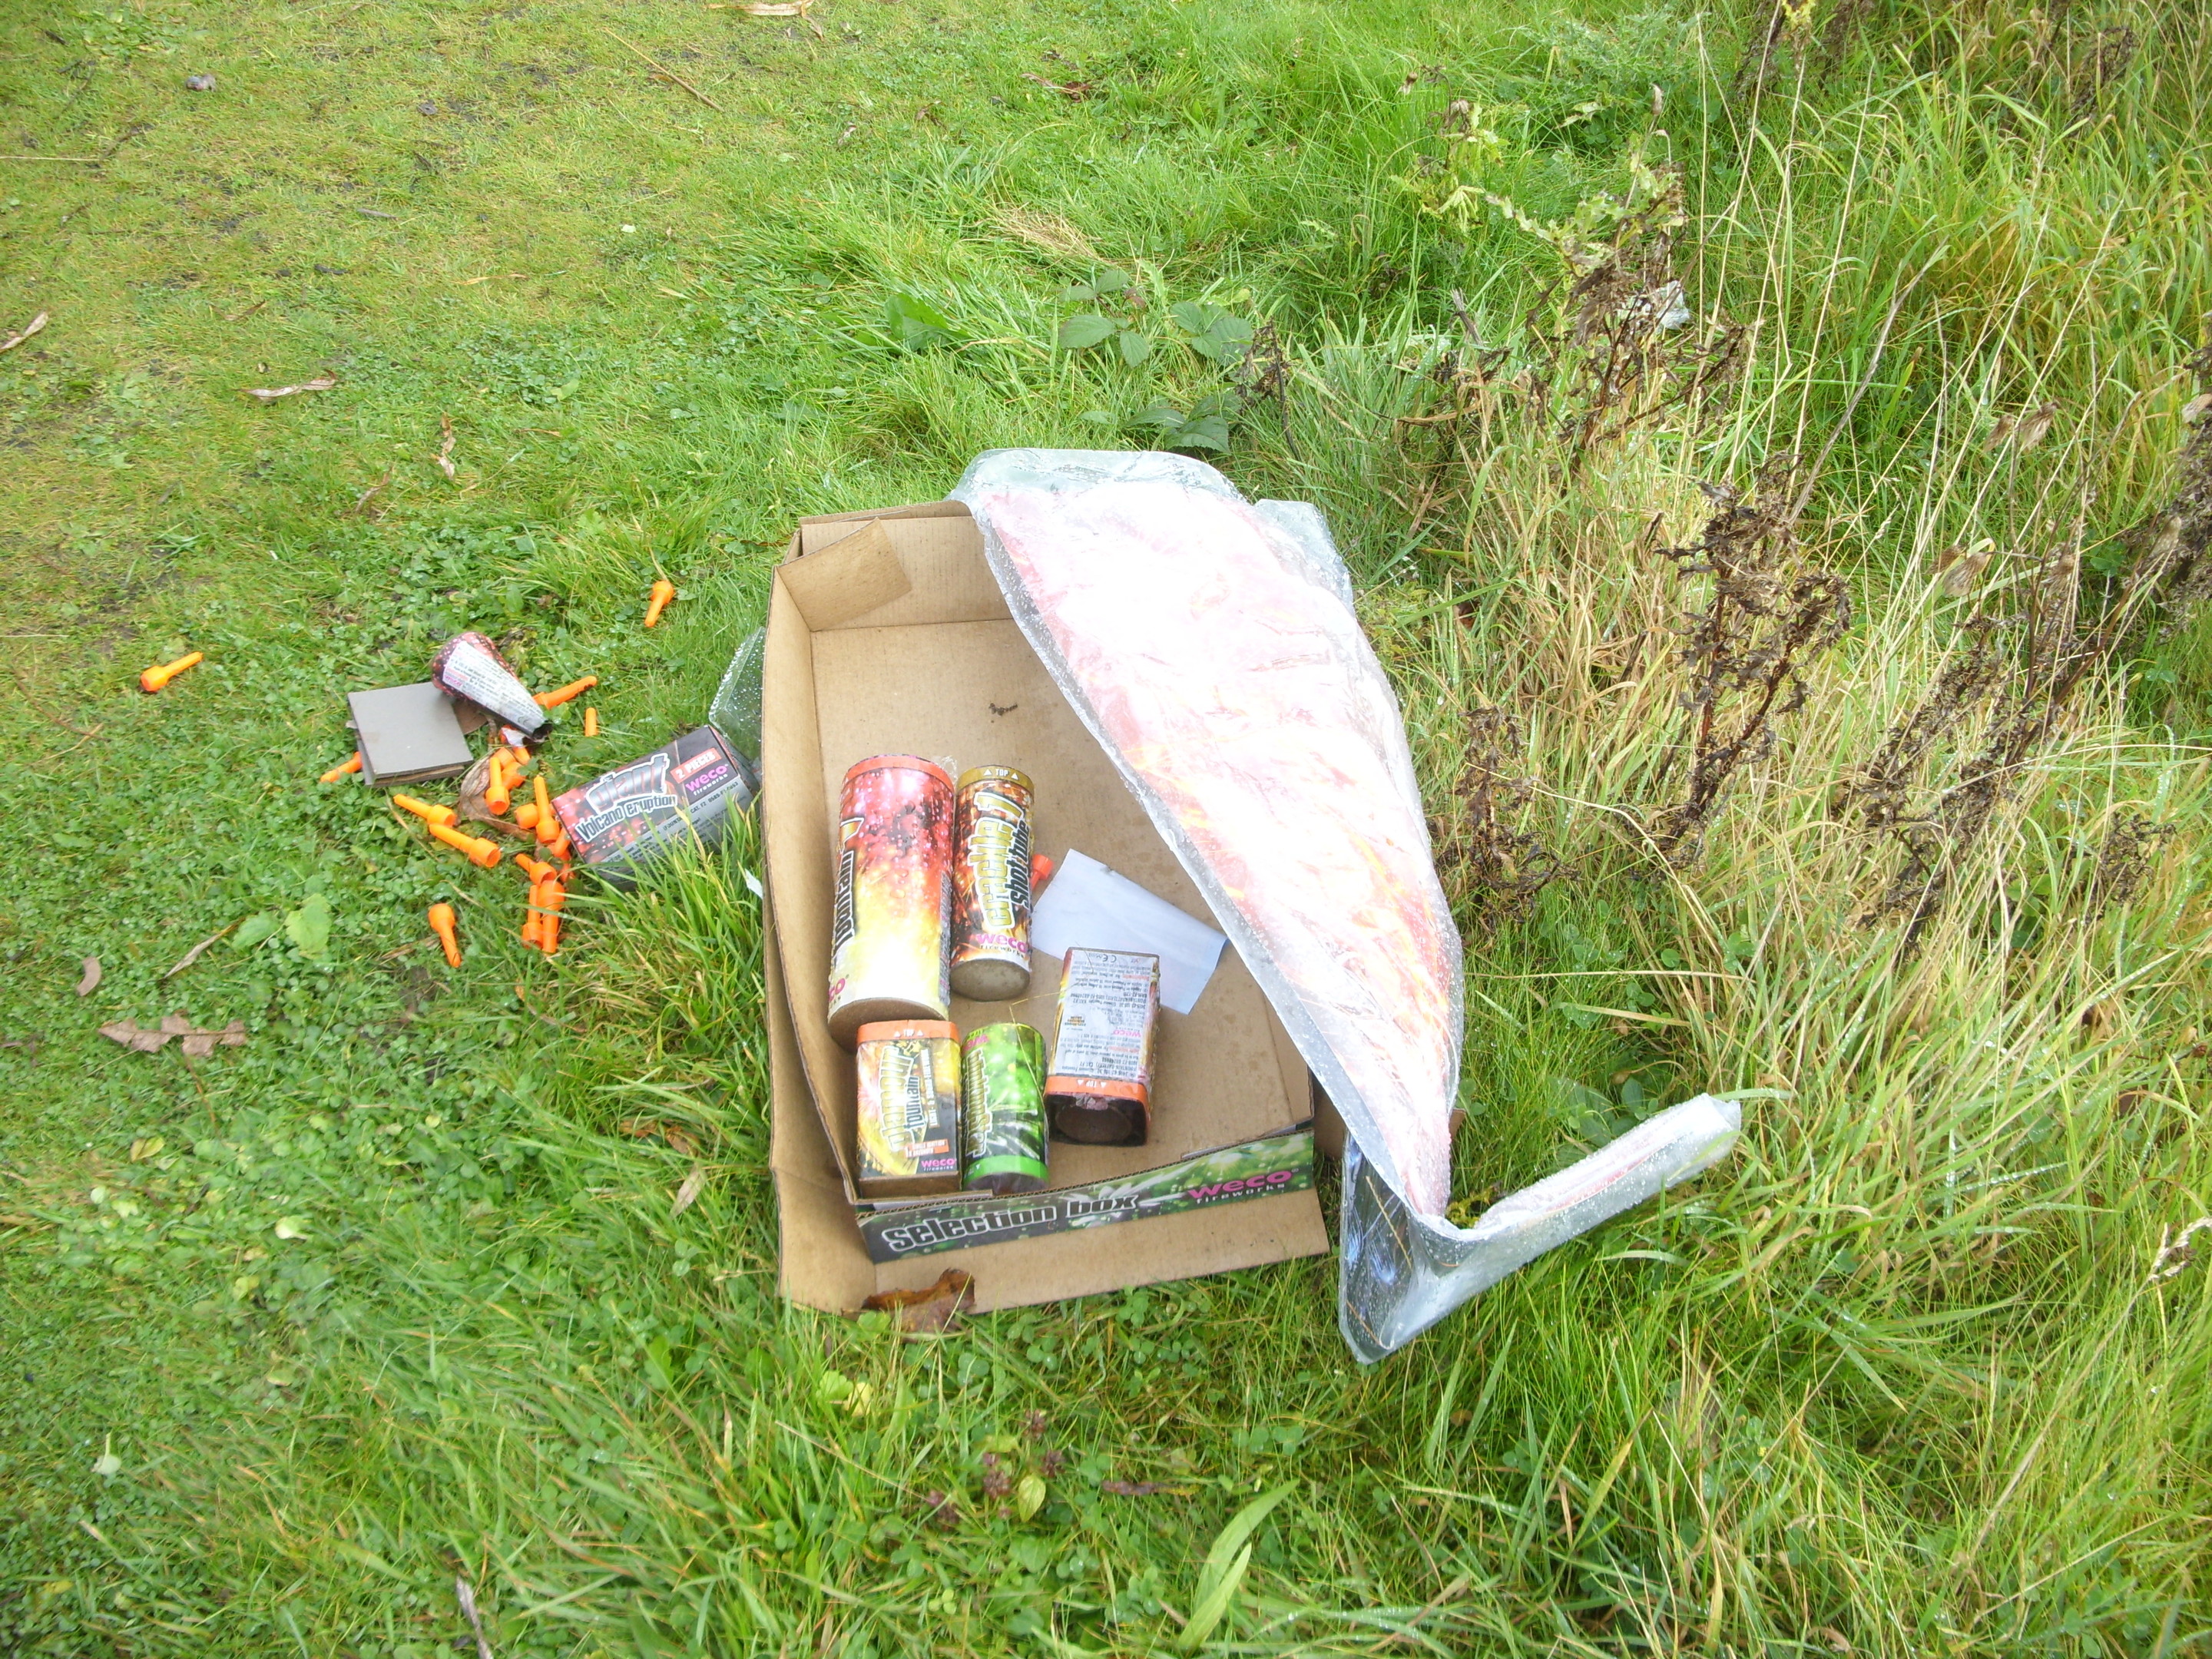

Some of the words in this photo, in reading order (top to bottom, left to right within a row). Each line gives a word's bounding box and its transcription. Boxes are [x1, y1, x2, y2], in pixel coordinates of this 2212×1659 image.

[675, 768, 684, 779] 2
[684, 751, 716, 773] PIECES
[686, 766, 727, 792] weco
[995, 768, 1008, 777] TOP
[586, 753, 670, 811] giant
[693, 773, 728, 796] fireworks
[576, 807, 625, 843] Volcano
[627, 794, 677, 817] eruption
[973, 790, 1025, 820] 1
[1008, 819, 1030, 866] tube
[968, 816, 1015, 929] crackle
[1004, 857, 1030, 910] shot
[1086, 1080, 1098, 1088] TOP
[879, 1045, 914, 1152] glamour
[903, 1076, 926, 1130] fountain
[922, 1158, 955, 1167] weco
[1187, 1171, 1293, 1198] weco
[1196, 1184, 1285, 1204] fireworks
[1066, 1194, 1139, 1218] box
